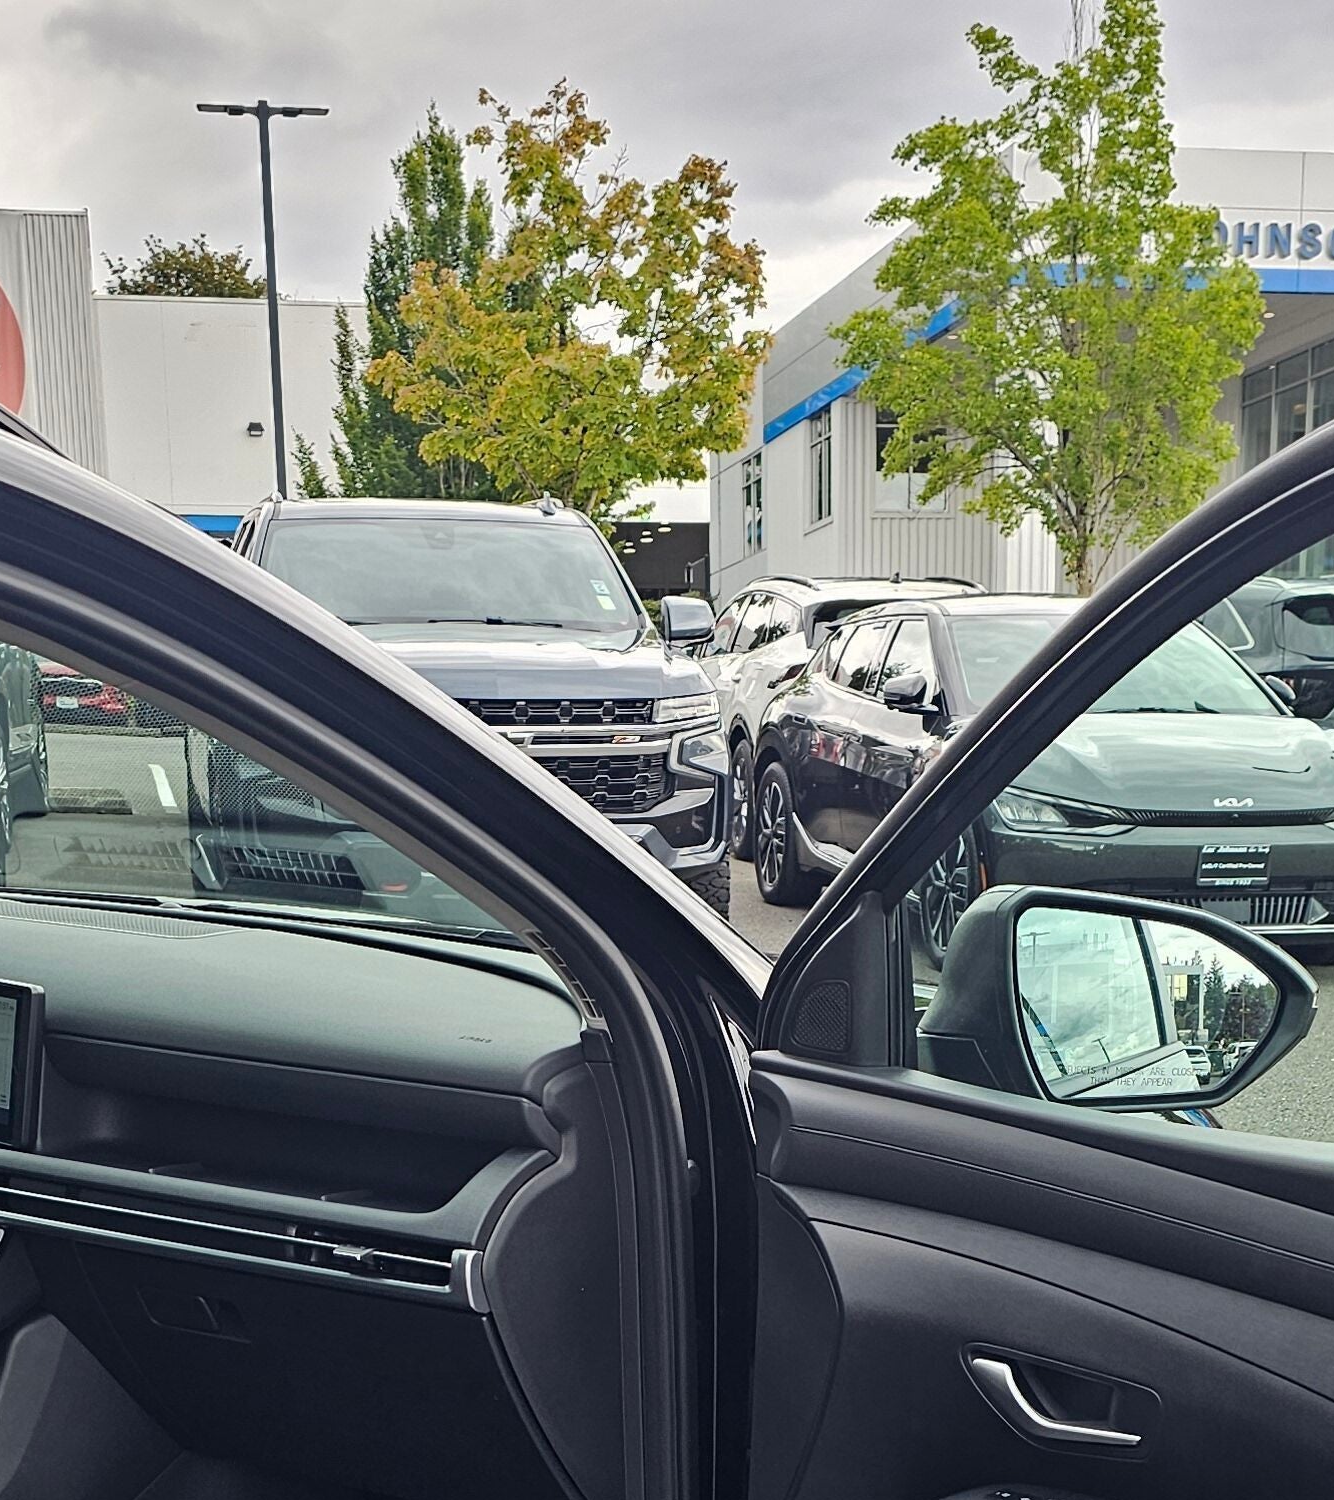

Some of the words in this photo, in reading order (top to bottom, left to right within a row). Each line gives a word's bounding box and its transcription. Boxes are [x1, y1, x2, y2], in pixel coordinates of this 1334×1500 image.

[1116, 1066, 1145, 1077] MIR
[1151, 1067, 1169, 1076] ARE
[1116, 1077, 1136, 1086] THEY
[1141, 1077, 1173, 1086] APPEAR
